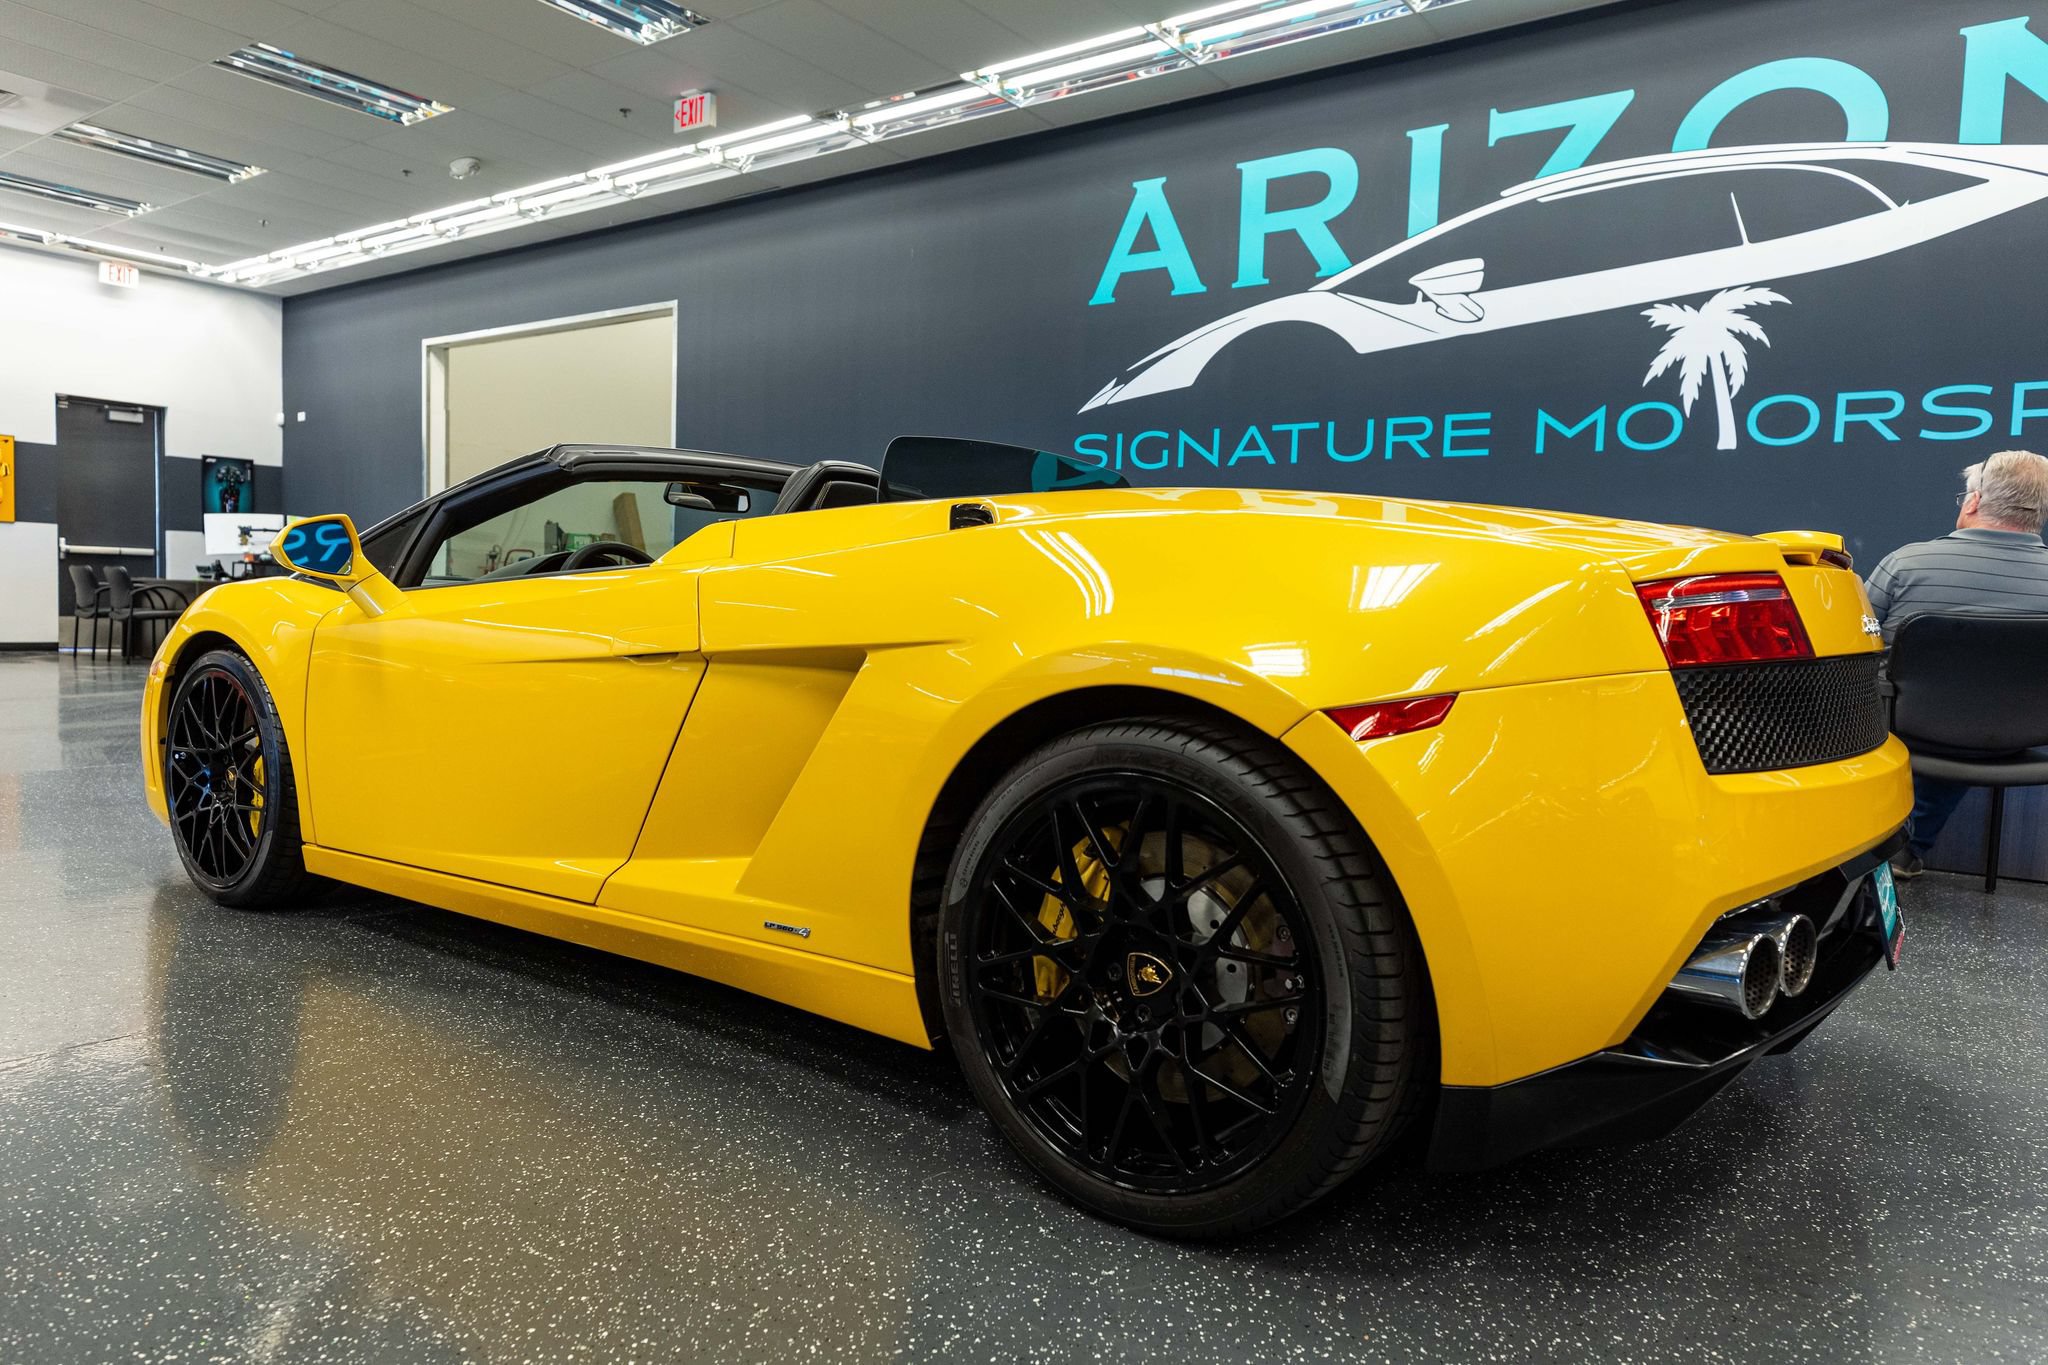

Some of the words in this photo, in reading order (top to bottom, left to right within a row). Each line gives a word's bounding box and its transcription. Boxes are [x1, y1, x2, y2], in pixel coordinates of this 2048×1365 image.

[681, 96, 705, 128] EXIT
[109, 263, 137, 285] EXIT
[1073, 411, 1492, 471] SIGNATURE
